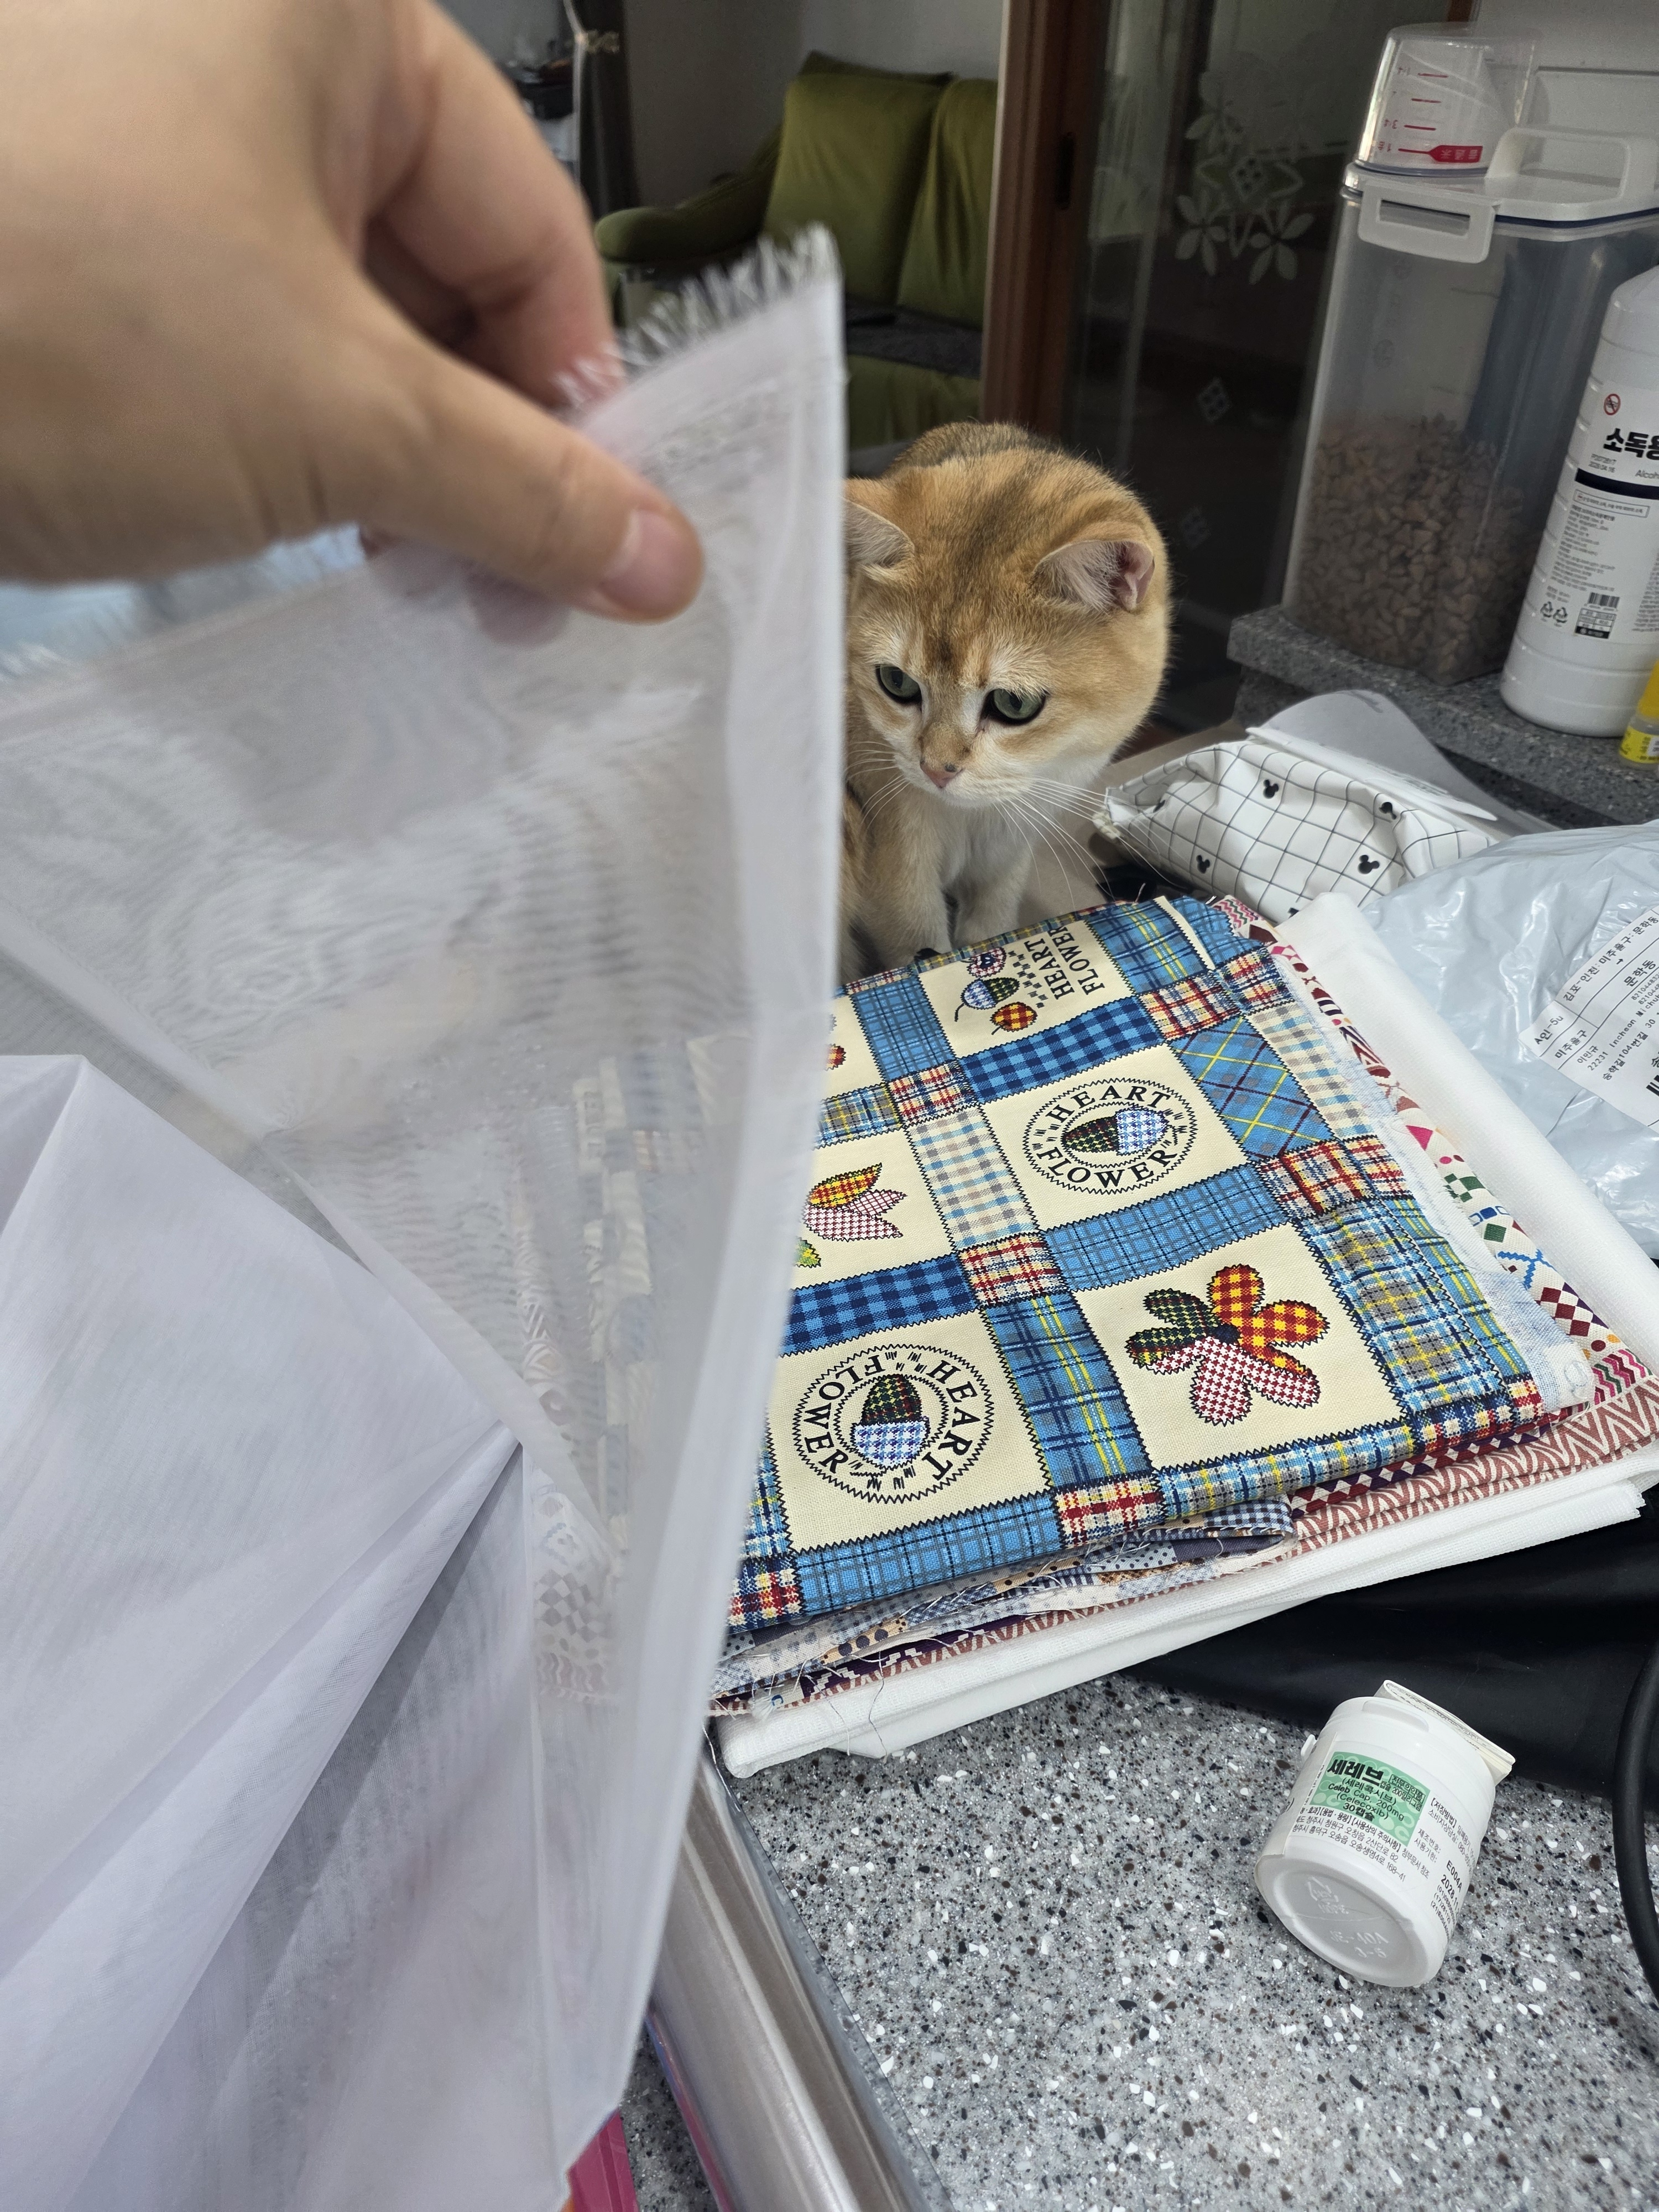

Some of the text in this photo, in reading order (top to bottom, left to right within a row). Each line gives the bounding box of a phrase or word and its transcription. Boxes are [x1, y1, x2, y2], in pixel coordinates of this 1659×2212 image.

[1603, 427, 1659, 460] 소독용
[1024, 937, 1075, 1000] HEART
[1046, 925, 1106, 995] FLOWER
[1624, 959, 1656, 987] 문학동
[1645, 1019, 1656, 1029] 30
[1555, 1030, 1587, 1060] 미추홀구
[1577, 1045, 1599, 1063] 이민규
[1587, 1051, 1608, 1071] 22231
[1609, 1019, 1636, 1048] Incheon
[1045, 1084, 1171, 1123] HEART
[1036, 1146, 1178, 1188] FLOWER
[804, 1355, 886, 1475] FLOWER
[922, 1359, 981, 1481] HEART
[1327, 1759, 1384, 1787] 세레브
[1391, 1787, 1423, 1812] 200밀리그램
[1328, 1783, 1350, 1793] Celeb
[1376, 1799, 1405, 1821] 200mg
[1342, 1777, 1397, 1806] (세레콕시브)
[1389, 1775, 1425, 1803] 전문의약품
[1337, 1792, 1389, 1820] (Celecoxib)
[1343, 1803, 1375, 1822] 30캡슐
[1292, 1824, 1406, 1882] 청주시 흥덕구 오송읍 오송생명4로 168-41
[1306, 1815, 1324, 1826] 청주시
[1324, 1819, 1344, 1832] 청원구
[1344, 1827, 1365, 1841] 오창읍
[1365, 1837, 1389, 1856] 2산단로
[1390, 1853, 1399, 1863] 82
[1402, 1848, 1422, 1870] 첨부문서
[1420, 1865, 1430, 1879] 참조
[1414, 1838, 1460, 1921] 사용기한: 2028.11.2
[1417, 1828, 1462, 1893] 제조번호: E004A
